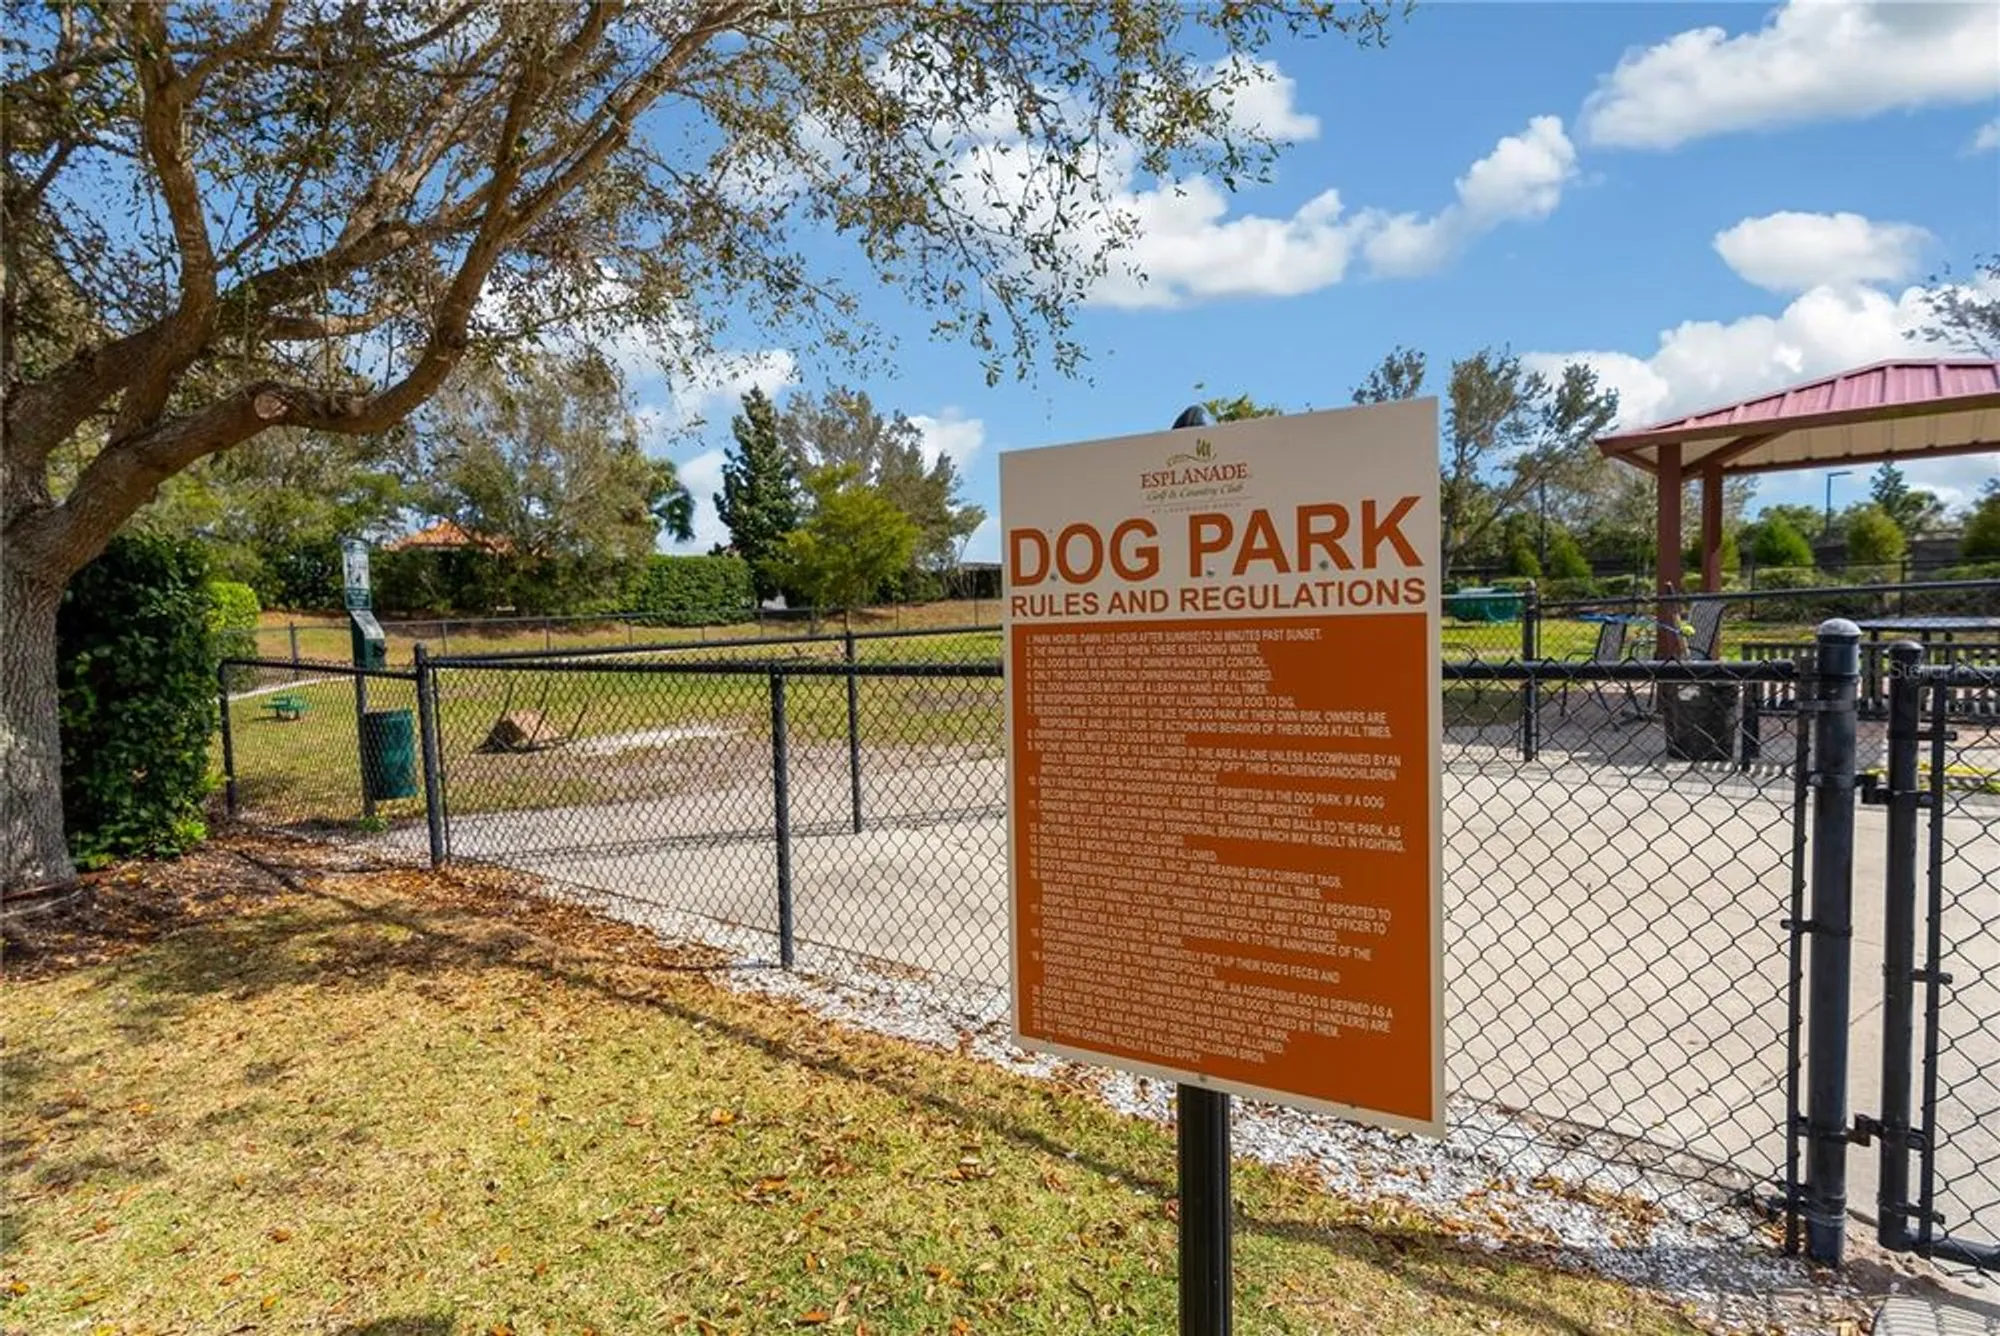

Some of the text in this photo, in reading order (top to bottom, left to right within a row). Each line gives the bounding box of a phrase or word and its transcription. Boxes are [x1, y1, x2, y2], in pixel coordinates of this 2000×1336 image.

[1141, 463, 1248, 489] ESPLANADE
[1009, 496, 1423, 587] DOG PARK
[1011, 577, 1426, 618] RULES AND REGULATIONS
